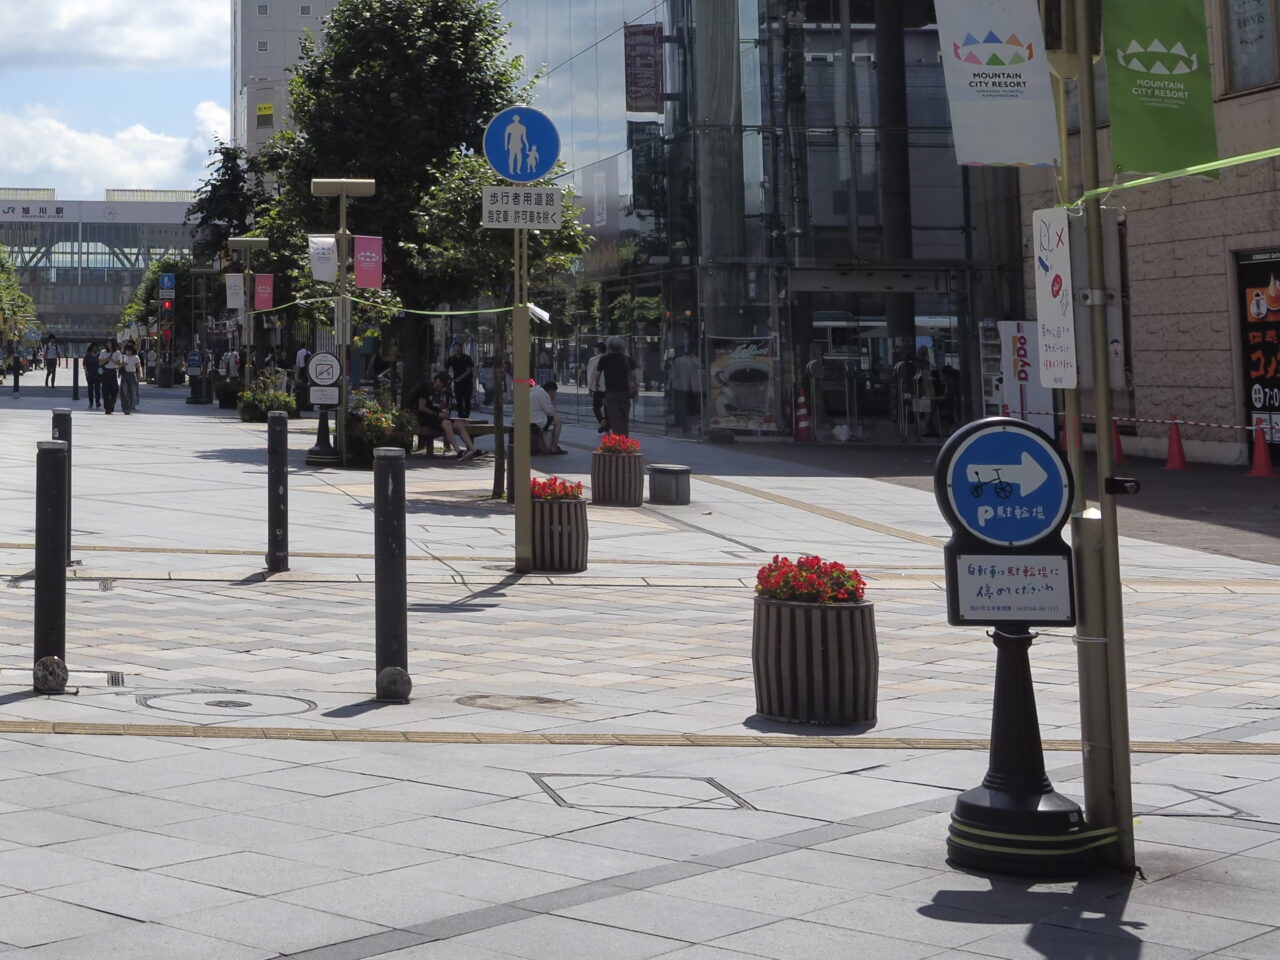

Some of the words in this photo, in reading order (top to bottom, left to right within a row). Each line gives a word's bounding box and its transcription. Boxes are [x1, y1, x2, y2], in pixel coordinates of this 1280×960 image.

[1136, 79, 1185, 90] MOUNTAIN
[1131, 87, 1152, 96] CITY
[1154, 89, 1189, 99] RESORT
[489, 191, 555, 206] 歩行者用道路
[1, 206, 16, 215] JR
[487, 209, 557, 224] 指定車・許可車を除く
[1017, 335, 1031, 382] DyDo
[1264, 387, 1280, 408] 7:0
[996, 505, 1046, 521] 駐輪場
